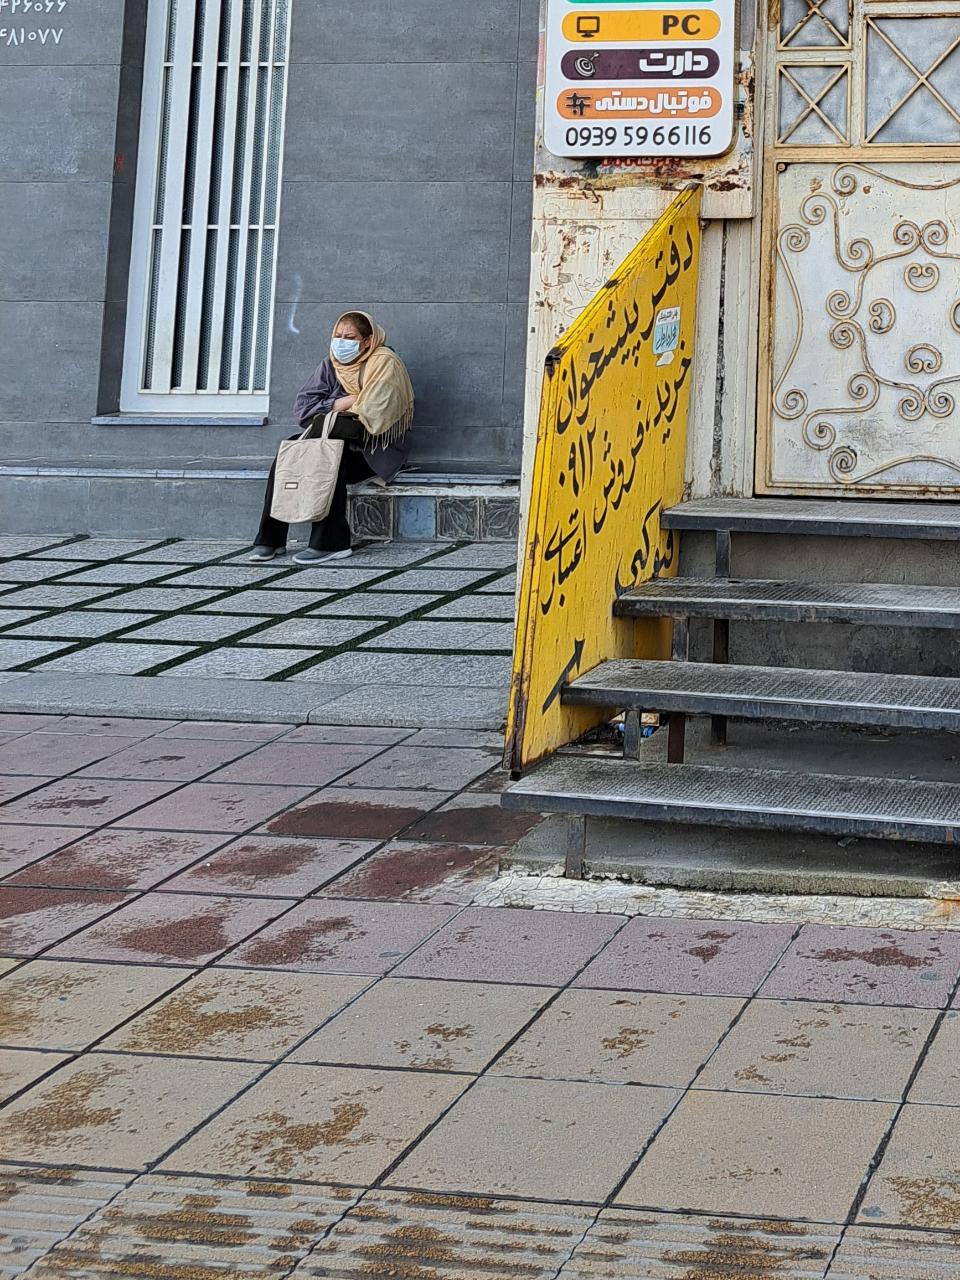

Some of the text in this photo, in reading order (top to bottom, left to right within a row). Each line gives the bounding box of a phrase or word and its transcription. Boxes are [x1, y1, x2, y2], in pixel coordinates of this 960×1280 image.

[662, 15, 701, 36] PC
[639, 52, 709, 76] دارت
[595, 90, 712, 115] فوتبال دستی
[565, 126, 617, 147] 0939
[640, 225, 694, 341] دفتر
[556, 298, 640, 435] پیشخوان
[559, 416, 597, 498] ۰۹۱۲
